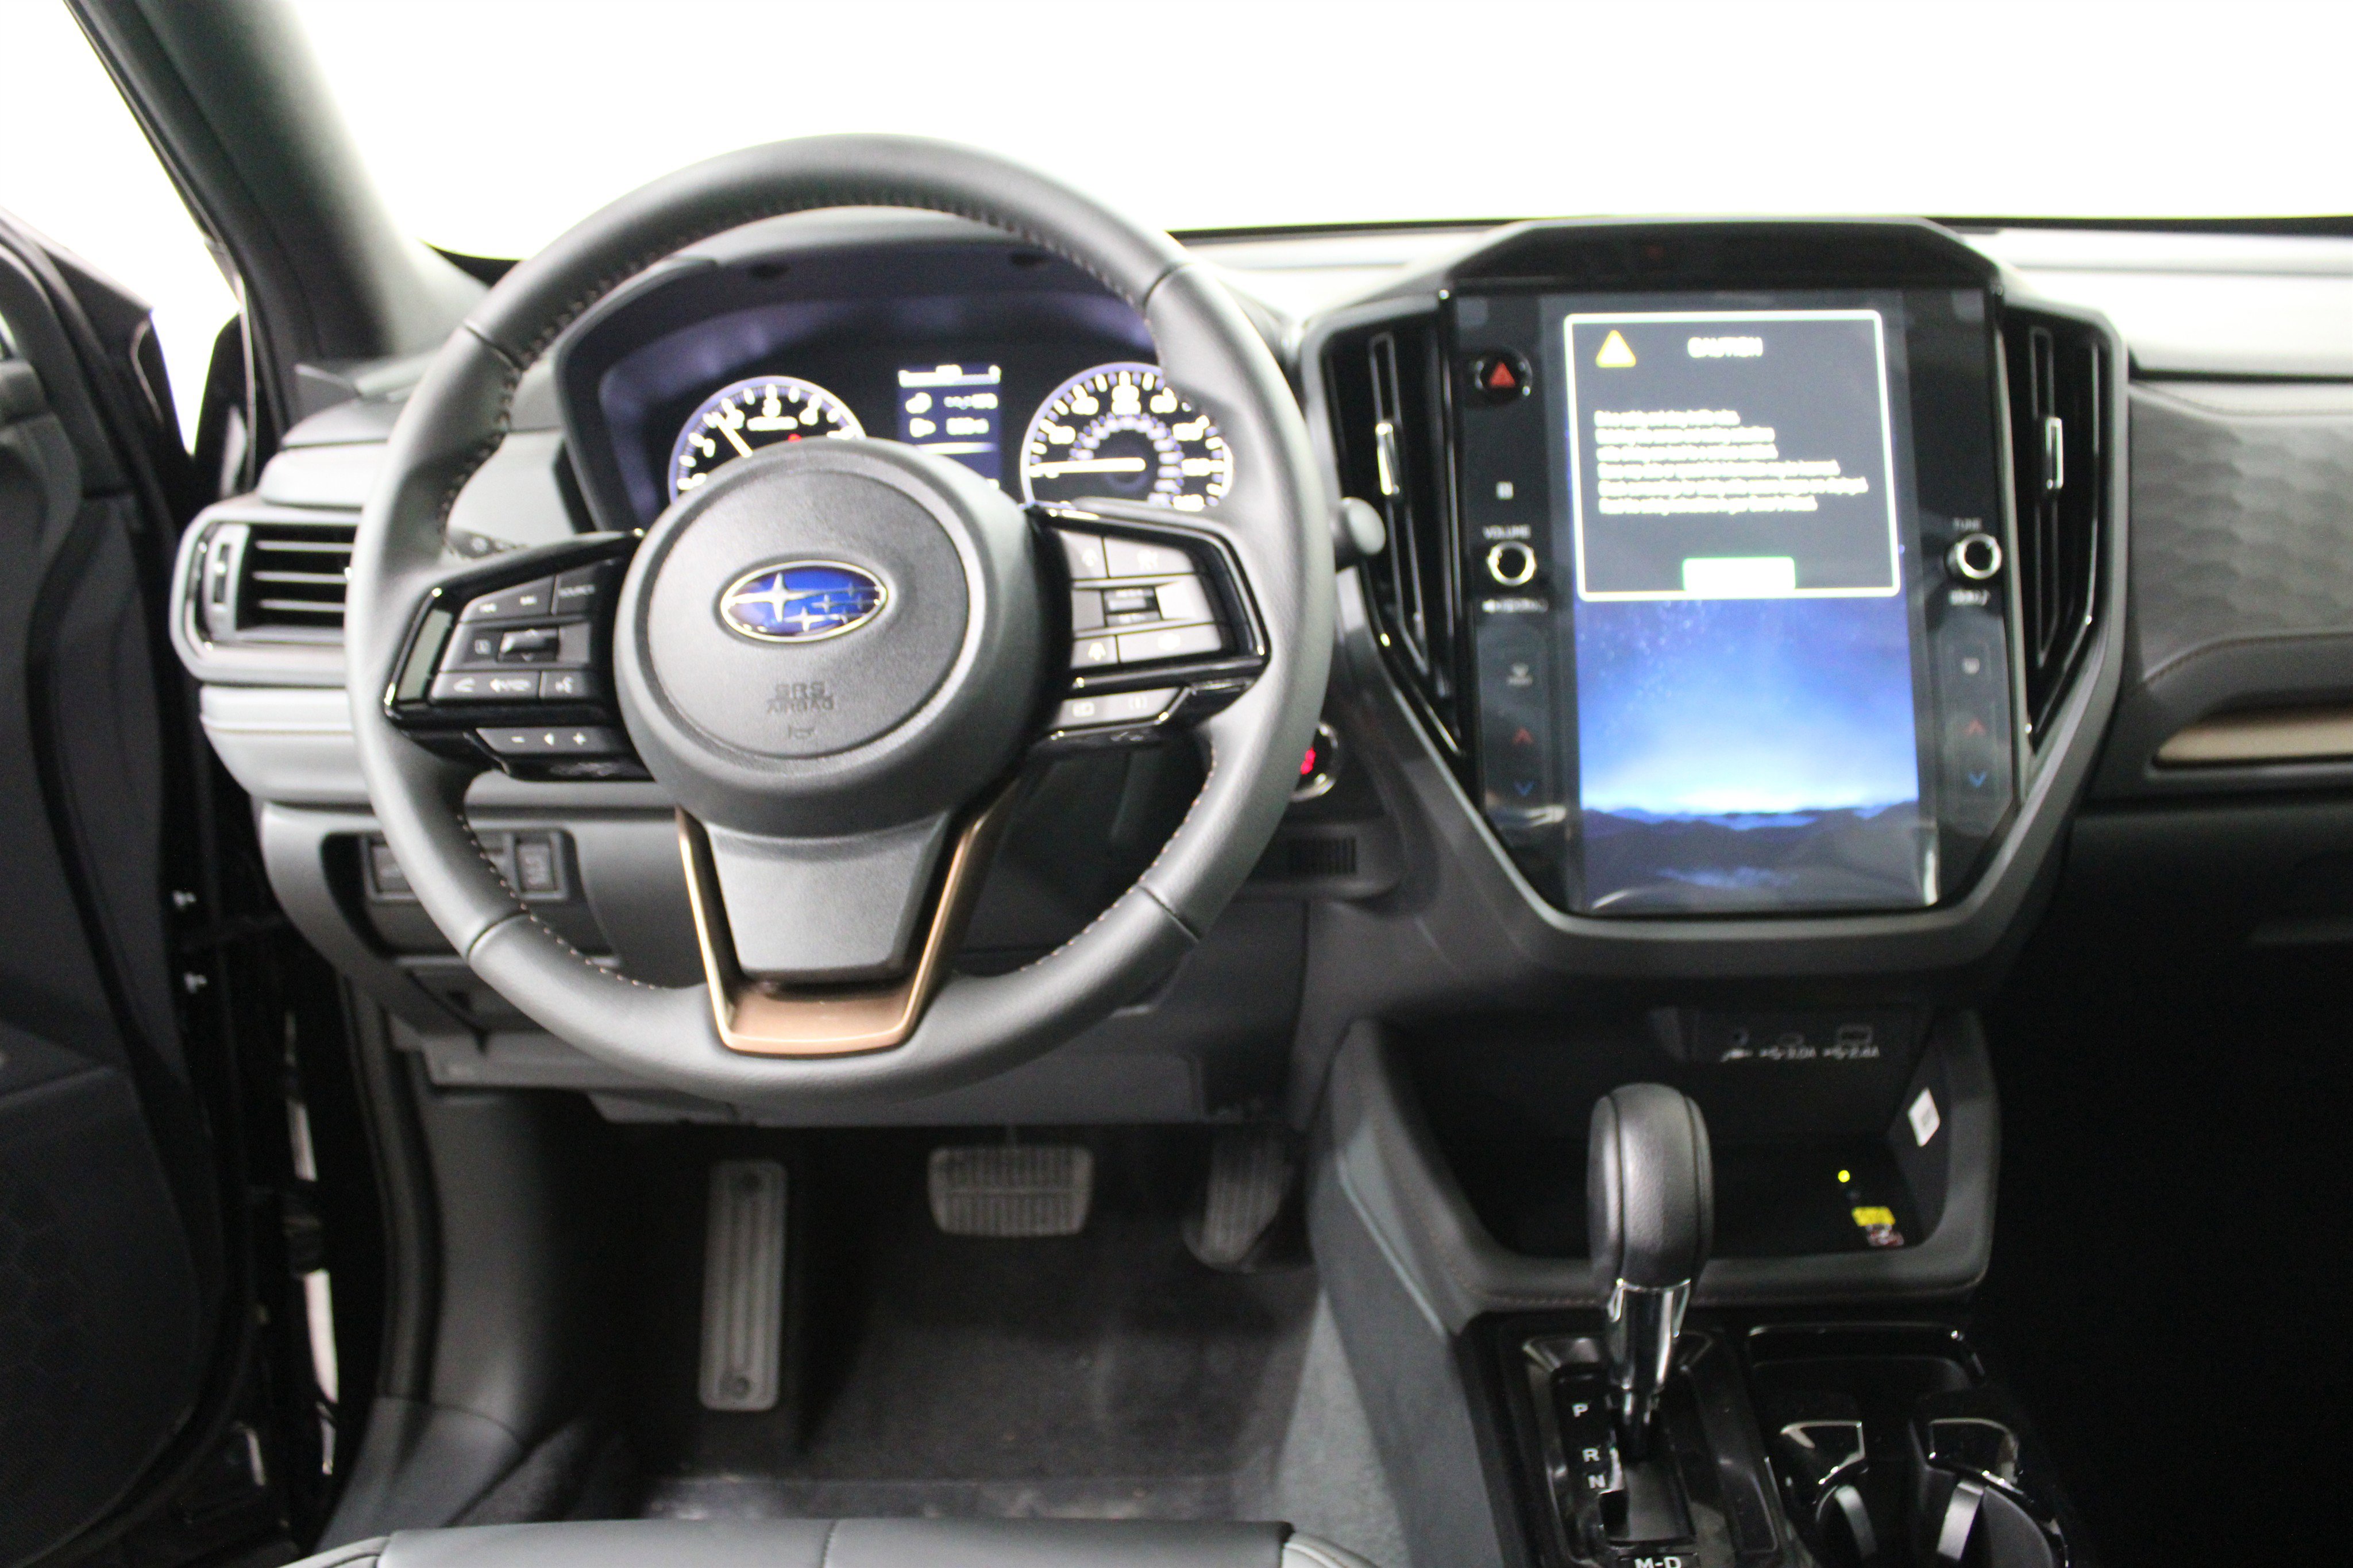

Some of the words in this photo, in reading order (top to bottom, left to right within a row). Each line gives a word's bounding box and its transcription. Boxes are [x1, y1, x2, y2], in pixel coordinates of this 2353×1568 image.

[1482, 524, 1532, 540] VOLUME
[775, 680, 826, 701] SRS
[1572, 1403, 1589, 1418] P
[1582, 1447, 1600, 1463] R
[1588, 1474, 1607, 1489] N
